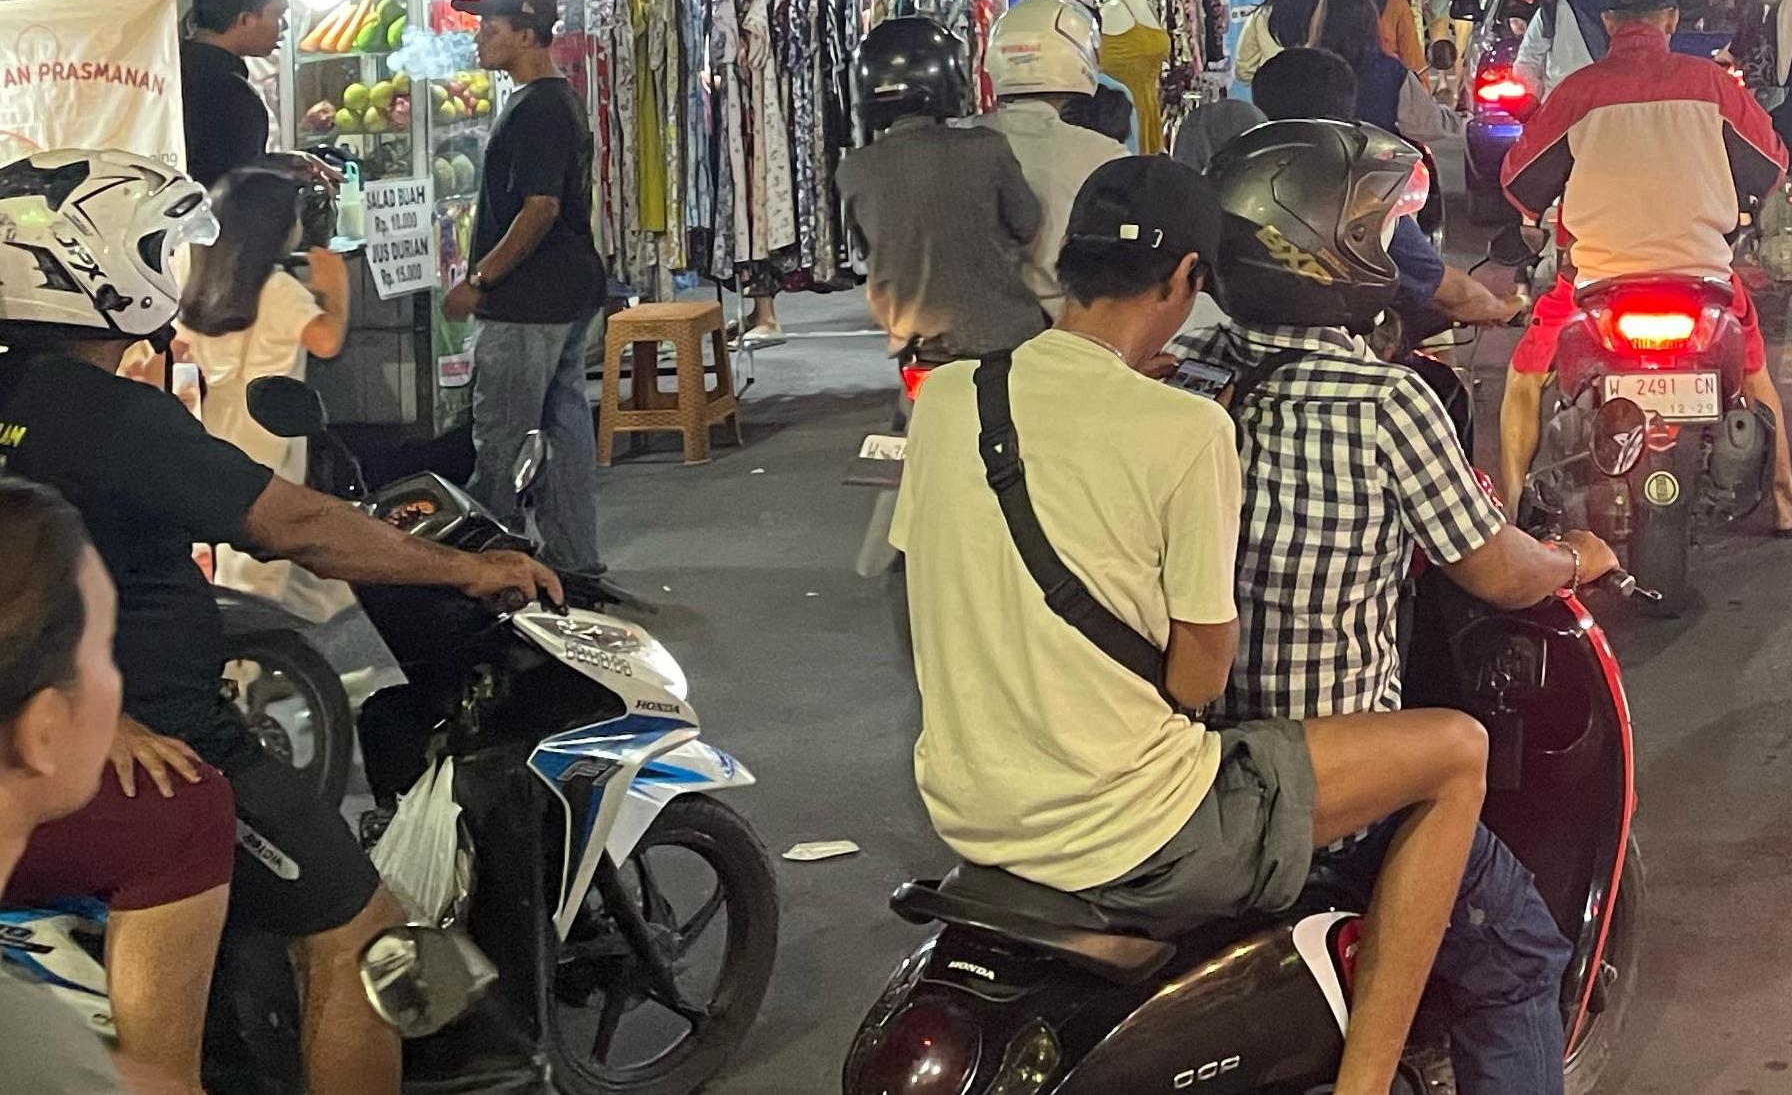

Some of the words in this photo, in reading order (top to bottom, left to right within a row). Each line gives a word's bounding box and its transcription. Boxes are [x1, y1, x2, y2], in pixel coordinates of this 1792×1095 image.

[38, 62, 166, 96] PRASMANAN
[372, 242, 390, 264] JUS
[391, 236, 429, 261] DURIAN
[1609, 379, 1620, 396] W
[1636, 378, 1676, 396] 2491
[1694, 377, 1714, 395] CN
[635, 699, 681, 714] HONDA
[948, 960, 996, 981] HONDA
